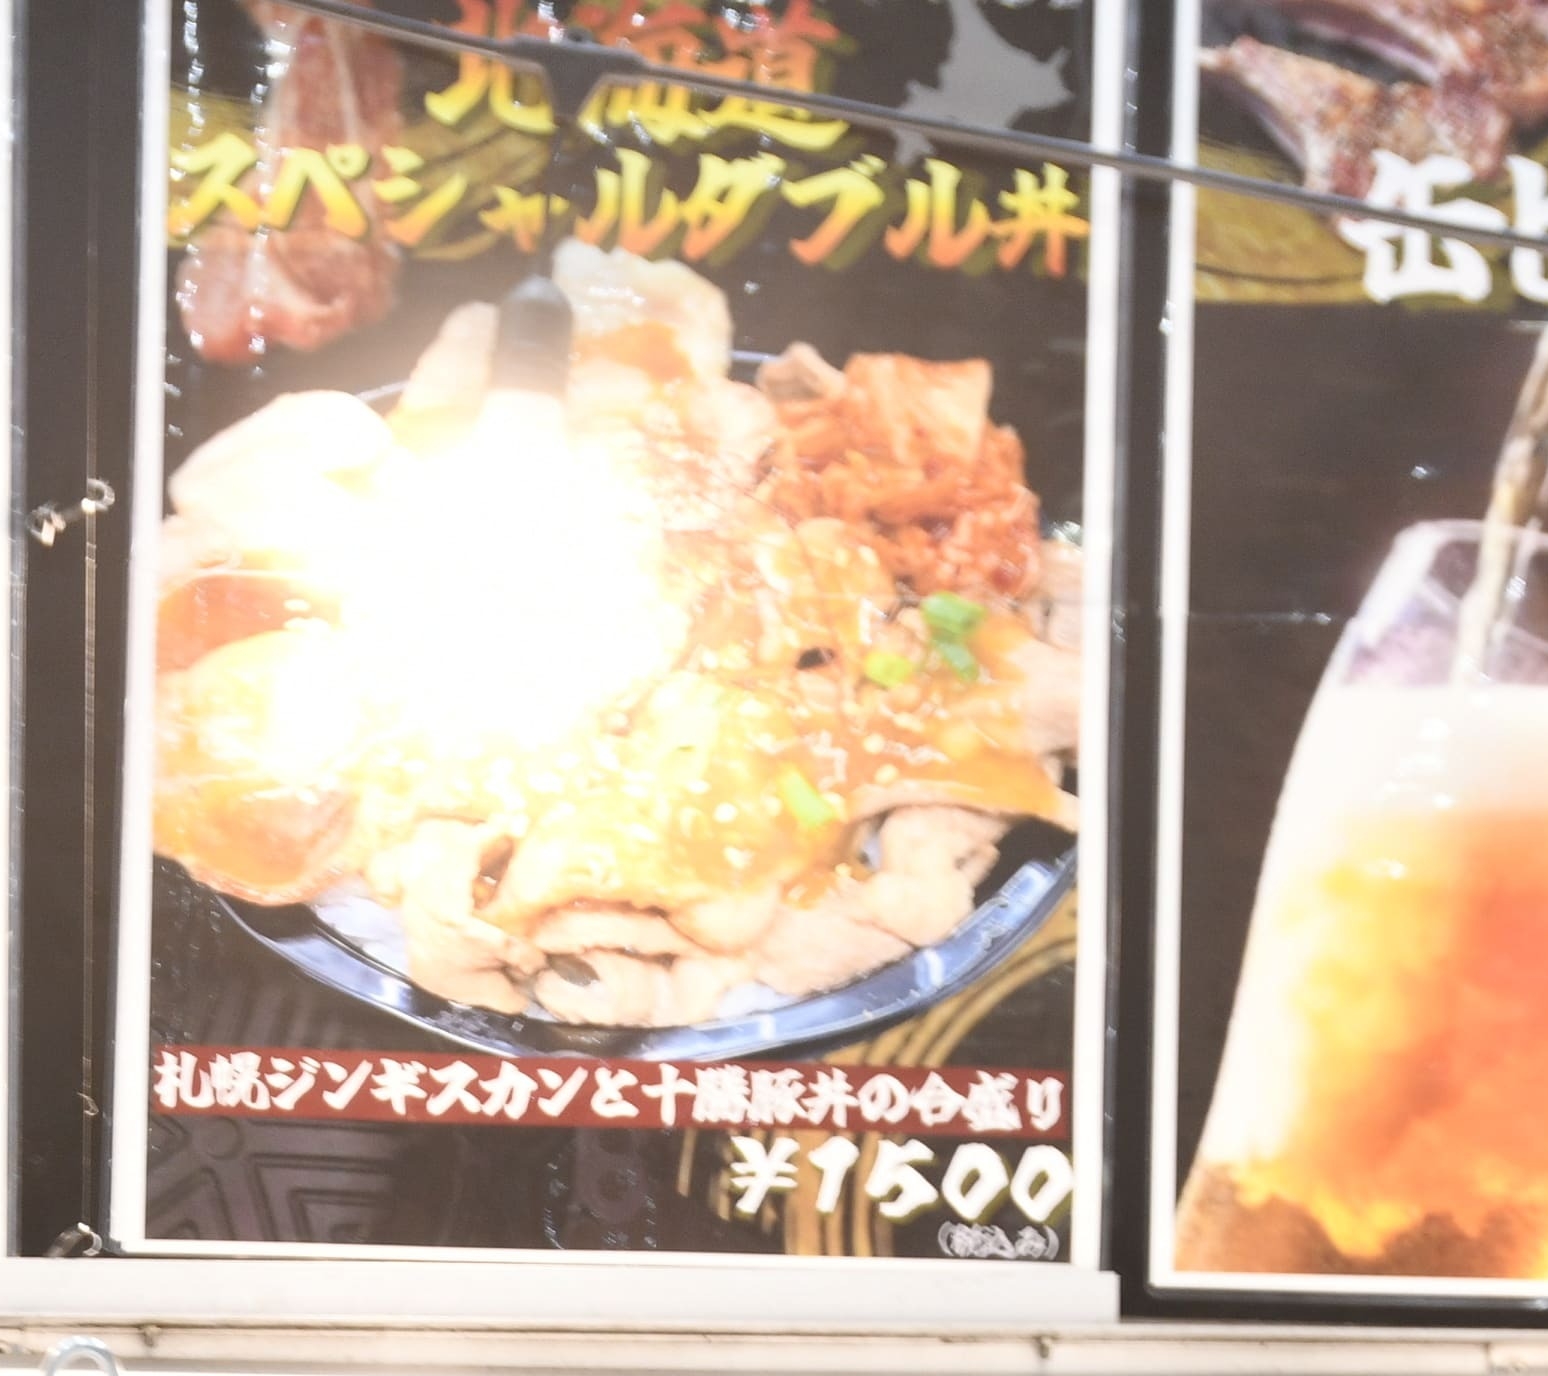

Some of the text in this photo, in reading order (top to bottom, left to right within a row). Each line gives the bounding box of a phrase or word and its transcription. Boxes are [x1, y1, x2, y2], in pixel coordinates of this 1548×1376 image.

[170, 132, 1090, 277] スペシャルダブル丼
[729, 1135, 1074, 1225] ¥1500
